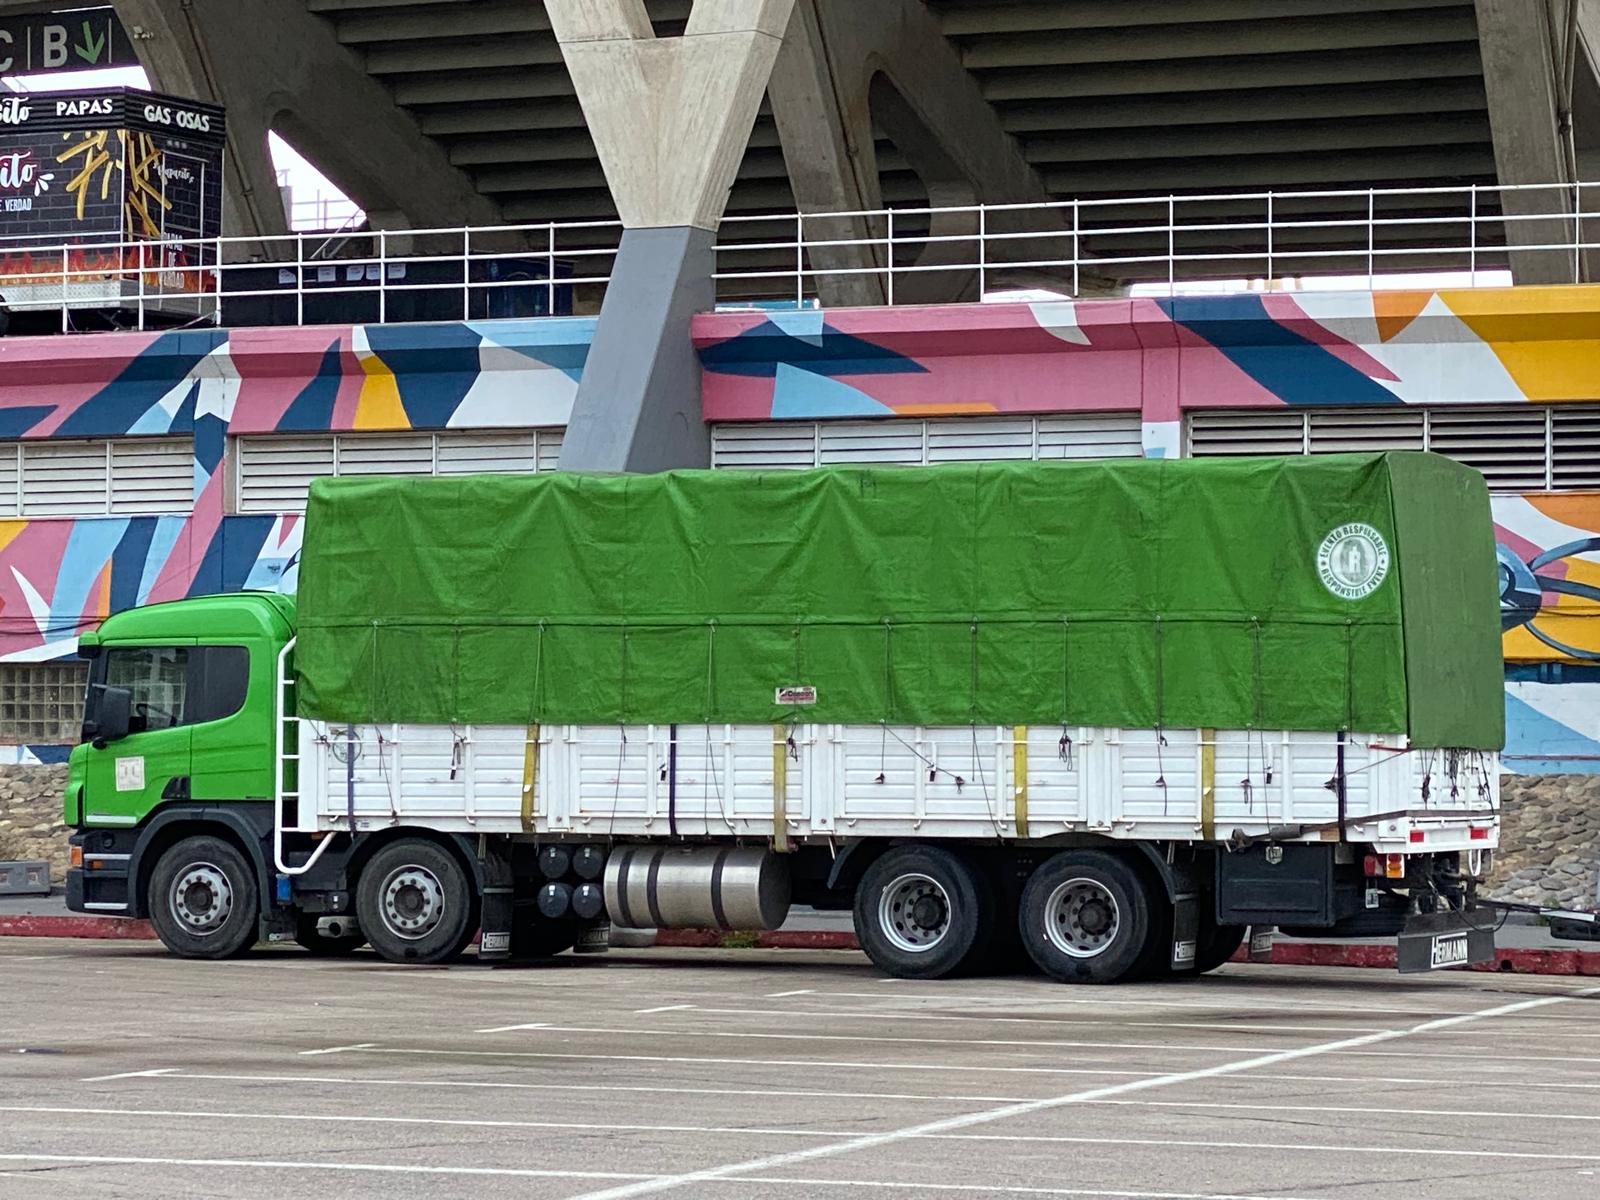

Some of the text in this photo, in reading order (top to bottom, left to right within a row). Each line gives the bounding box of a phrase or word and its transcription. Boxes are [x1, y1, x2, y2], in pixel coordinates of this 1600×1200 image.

[43, 24, 68, 68] B
[0, 97, 33, 125] ito
[56, 99, 113, 116] PAPAS
[144, 105, 210, 132] GAS OSAS
[5, 198, 32, 211] VERDAD
[1320, 530, 1342, 558] EVENTO
[1367, 566, 1386, 590] EVENT
[1431, 932, 1467, 968] HERMANN
